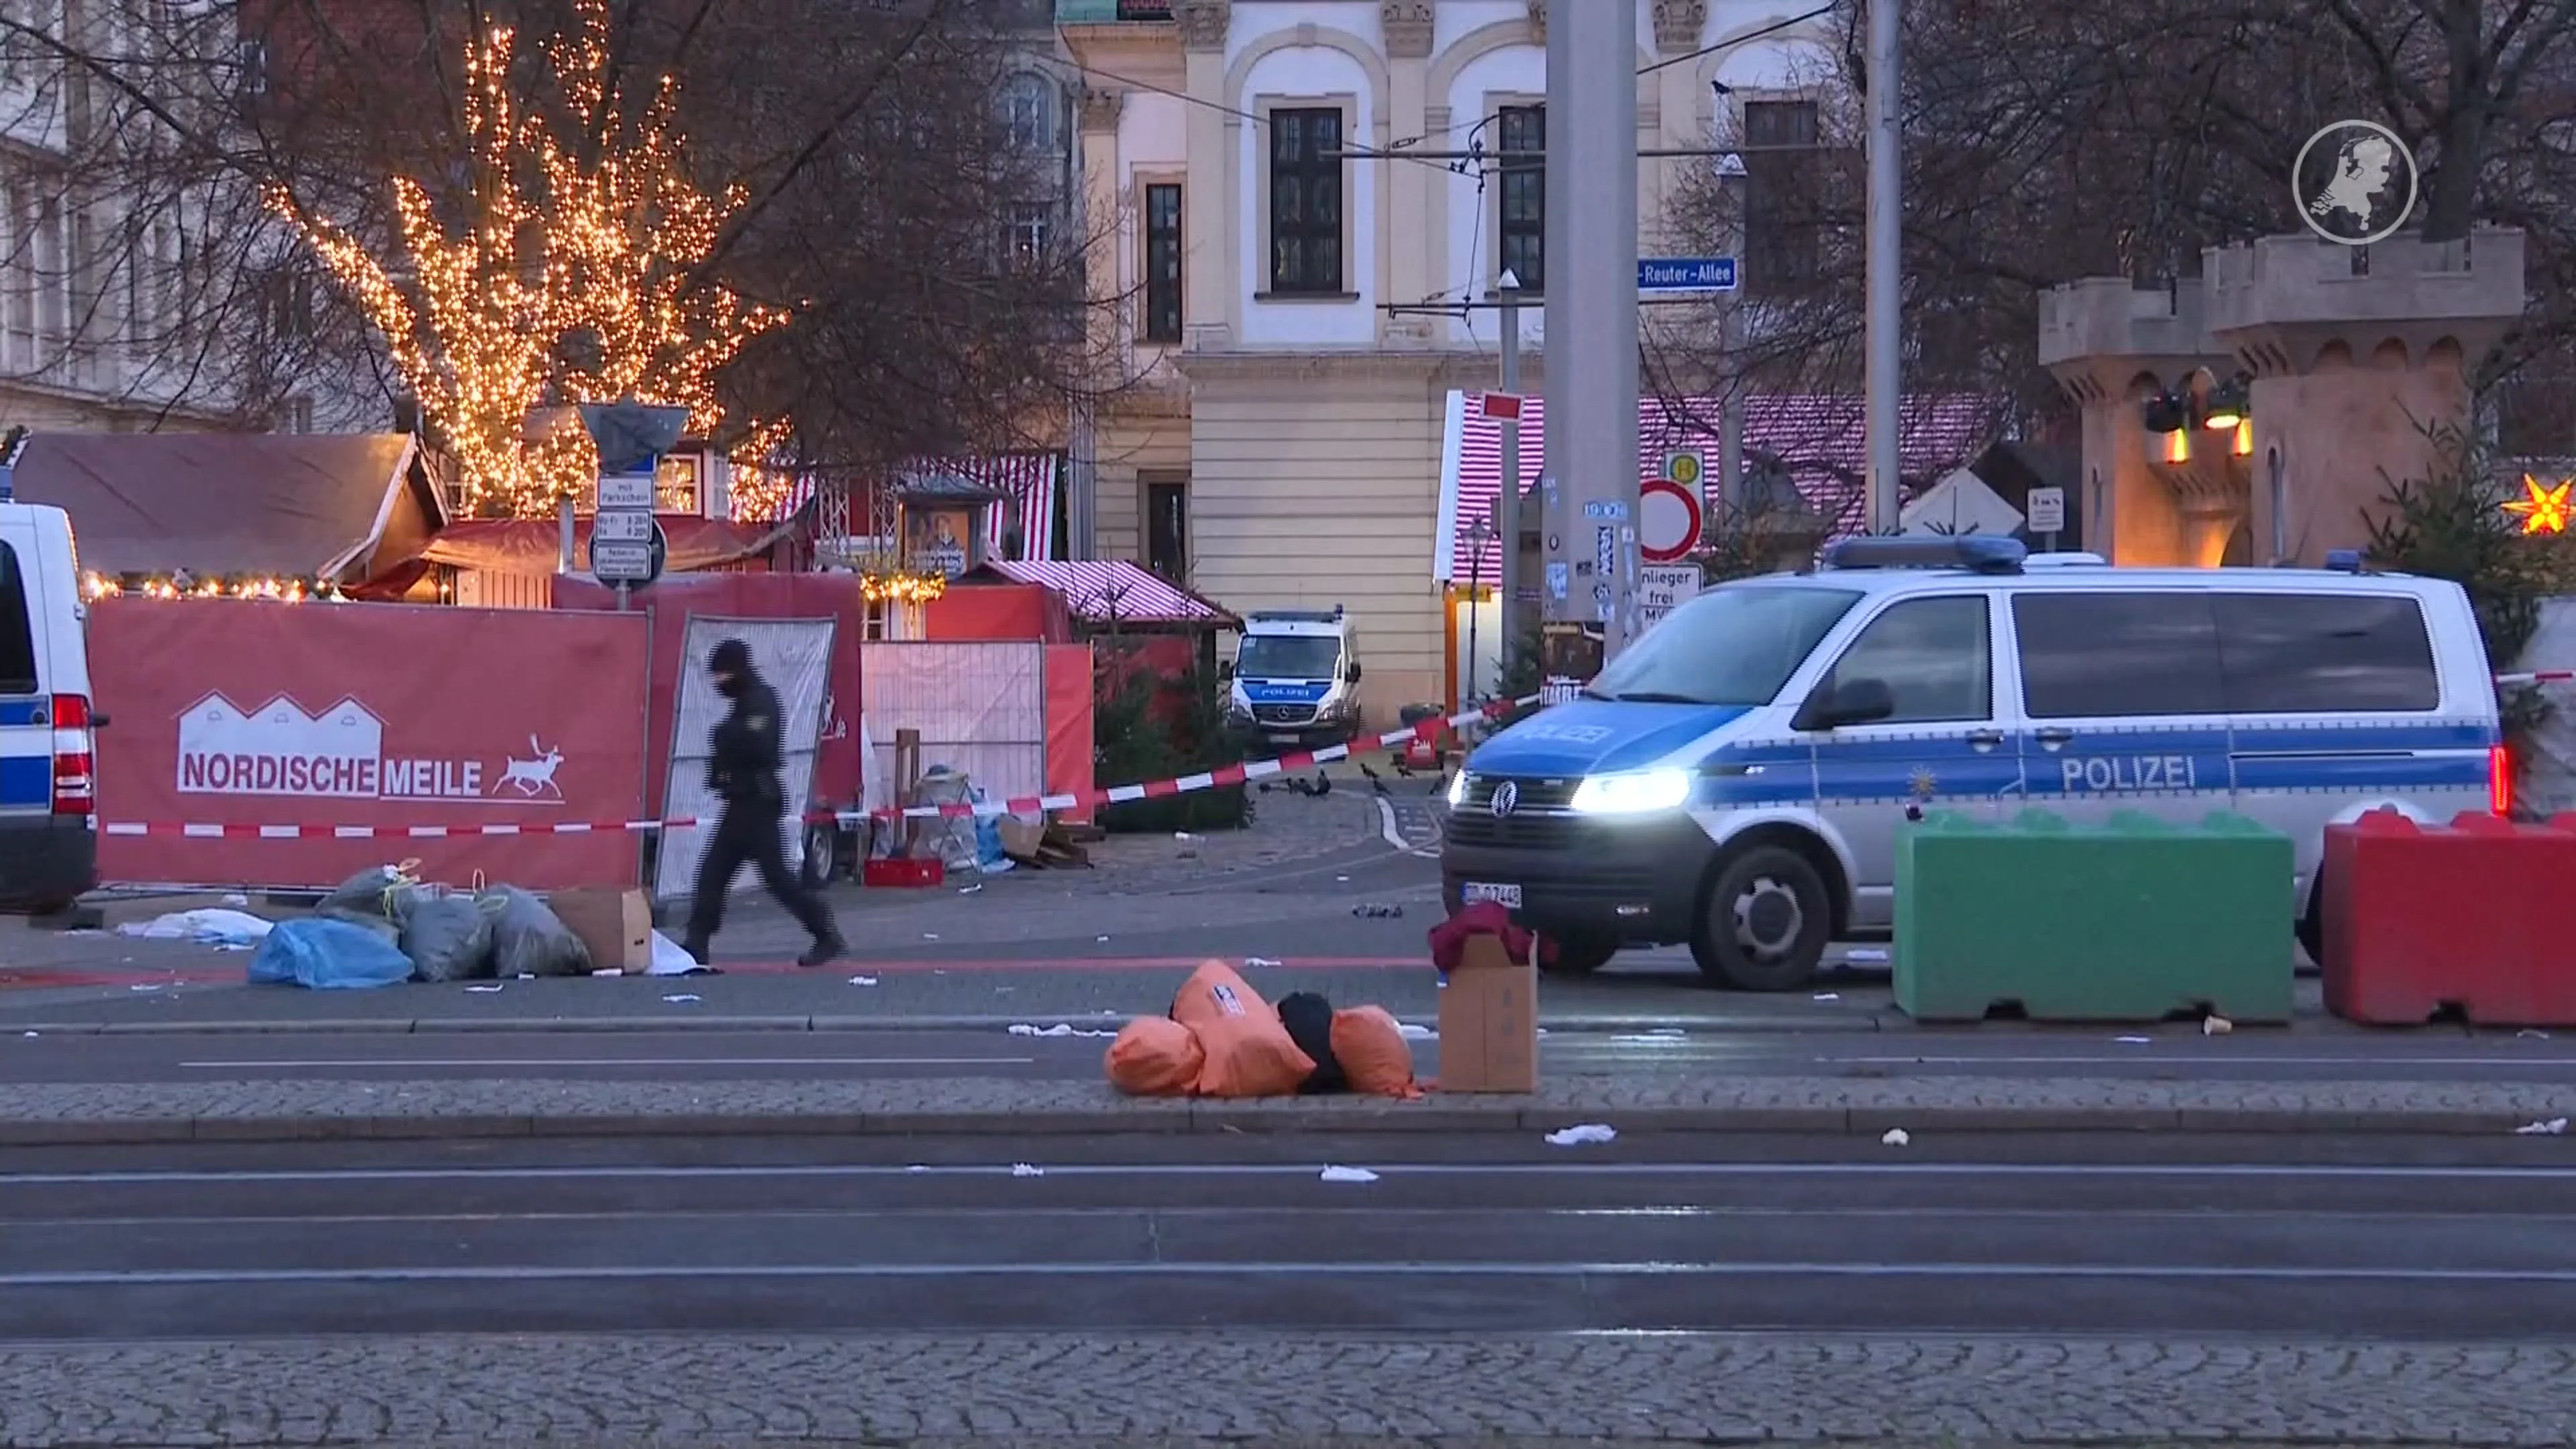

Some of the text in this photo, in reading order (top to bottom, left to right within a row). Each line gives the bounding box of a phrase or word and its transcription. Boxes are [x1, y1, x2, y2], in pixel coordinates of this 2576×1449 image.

[1637, 264, 1731, 282] -Reuter-Allee
[1642, 570, 1691, 588] nlieger
[1650, 590, 1674, 604] frei
[1646, 608, 1669, 621] MV
[1261, 689, 1309, 698] POLIZEI
[183, 752, 482, 796] NORDISCHE MEILE
[2061, 755, 2196, 790] POLIZEI
